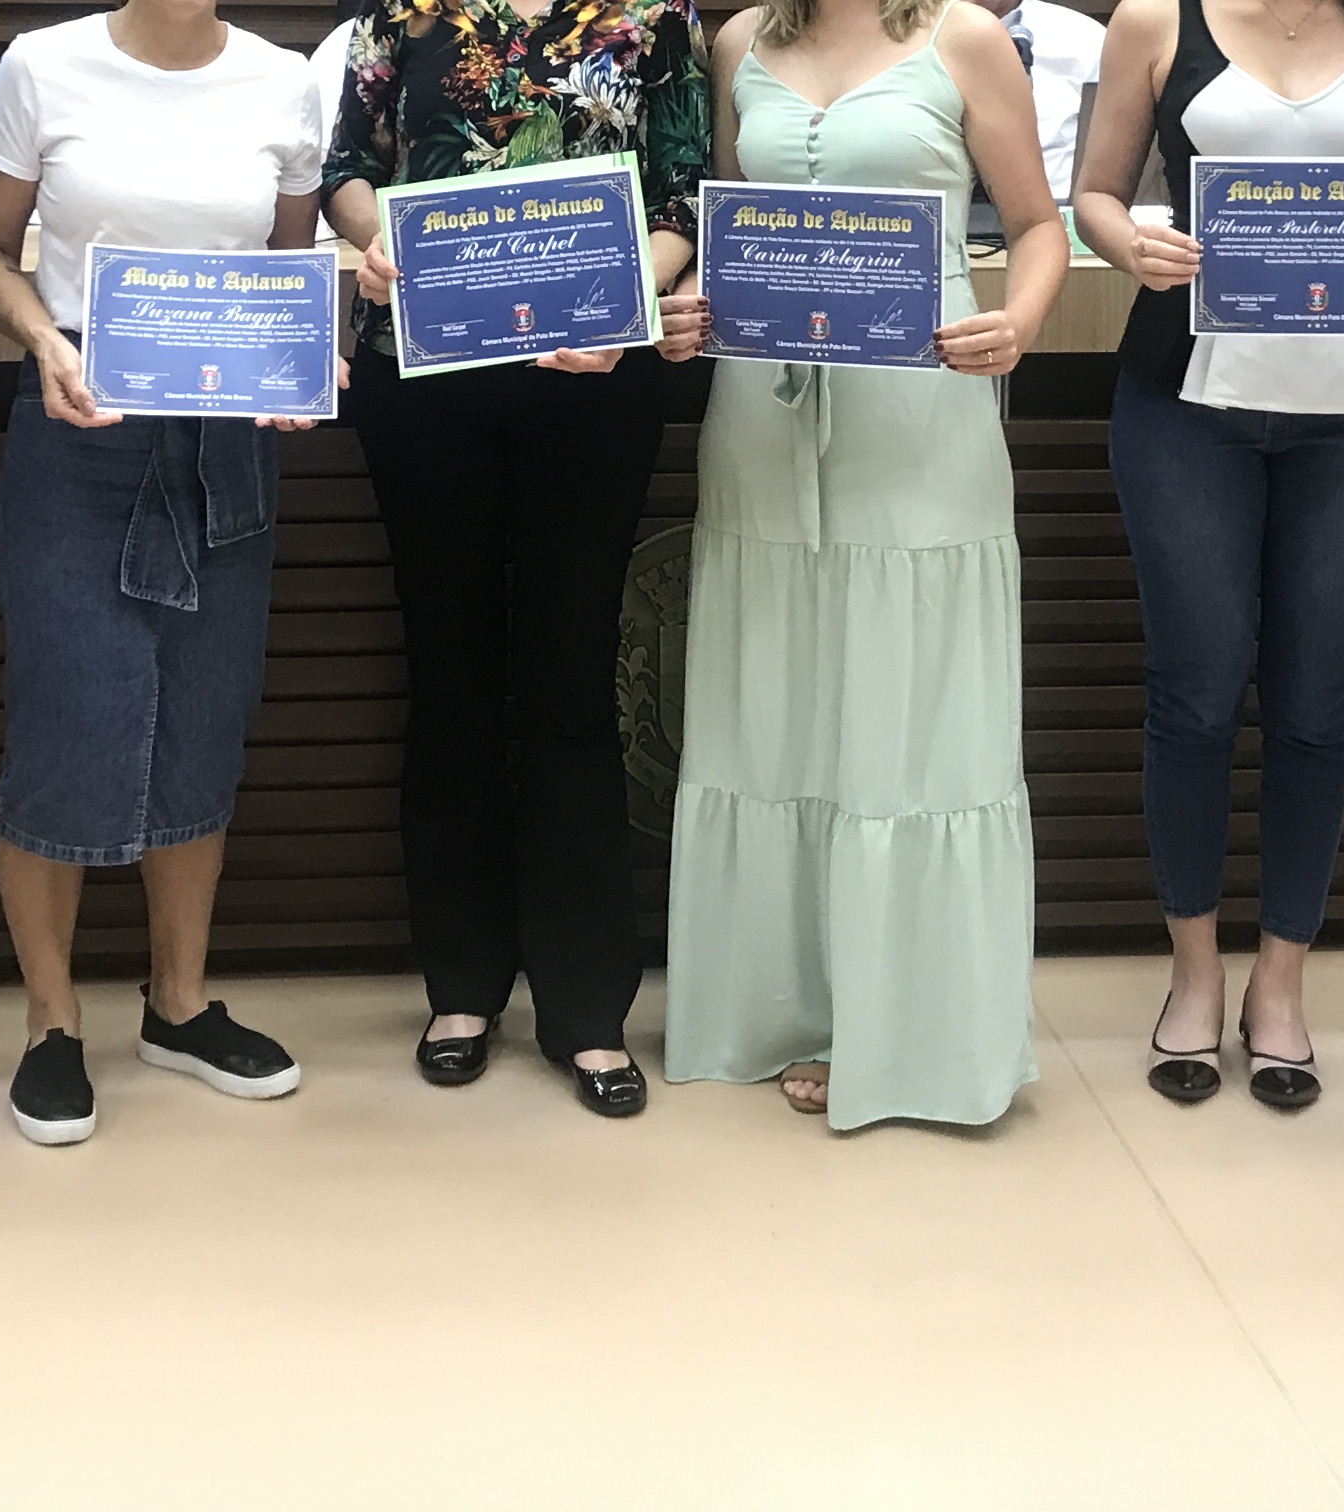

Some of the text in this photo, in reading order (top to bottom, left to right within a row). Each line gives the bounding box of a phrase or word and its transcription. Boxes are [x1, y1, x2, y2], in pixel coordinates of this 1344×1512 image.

[1226, 180, 1294, 205] Moção
[1299, 182, 1322, 201] de
[422, 207, 489, 235] Moção
[494, 204, 516, 224] de
[522, 196, 605, 222] Aplauso
[732, 205, 913, 234] Moção de Aplauso
[455, 240, 501, 262] Red
[740, 242, 905, 274] Carina Pelegrini
[121, 266, 306, 294] Moção de Aplauso
[218, 304, 294, 329] Baggio
